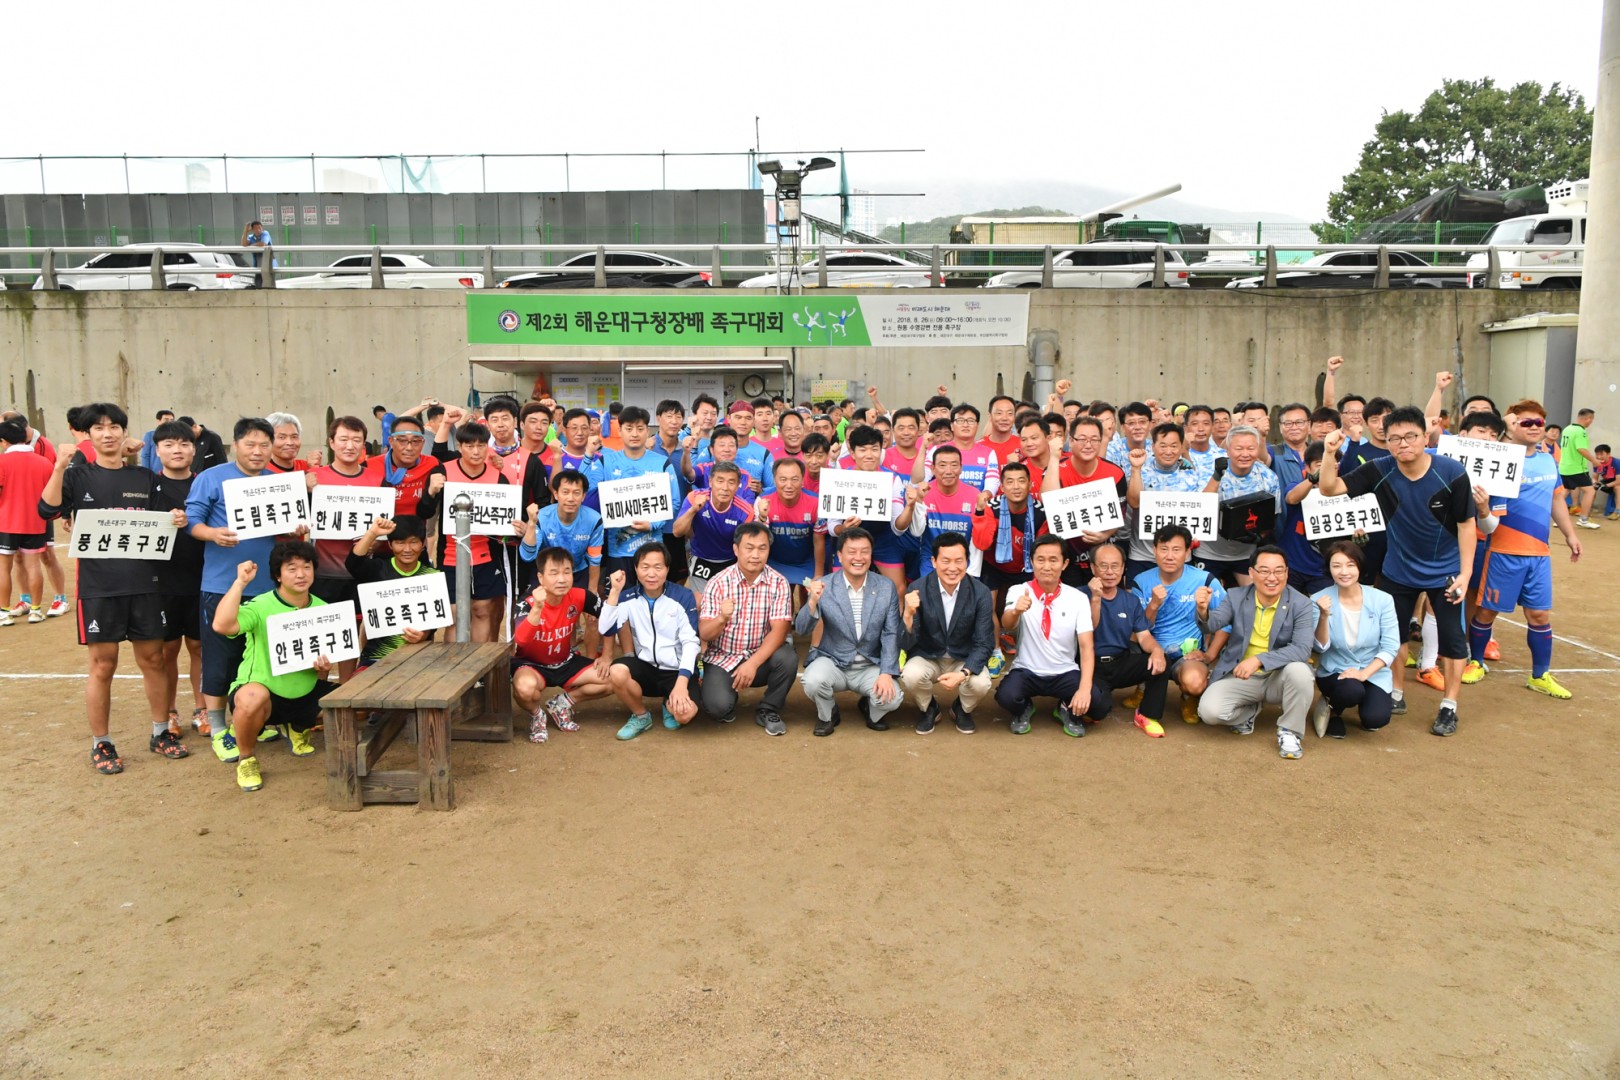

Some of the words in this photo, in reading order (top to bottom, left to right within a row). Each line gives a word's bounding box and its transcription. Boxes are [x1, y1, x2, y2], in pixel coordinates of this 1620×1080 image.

[525, 312, 568, 332] 제2회
[574, 311, 705, 334] 해운대구청장배
[710, 311, 784, 334] 족구대회
[1443, 452, 1517, 482] 지족구회
[243, 486, 267, 497] 해운대구
[269, 484, 292, 493] 족구협회
[327, 495, 356, 503] 부산광역시
[359, 496, 382, 504] 족구협회
[234, 499, 307, 530] 드림족구회
[605, 494, 669, 520] 재미사마족구회
[822, 494, 887, 516] 해마족구회
[97, 519, 127, 527] 해운대구
[941, 520, 968, 531] HORSE
[1053, 501, 1119, 533] 올킬족구회
[1309, 507, 1382, 534] 일공오족구회
[78, 533, 170, 553] 풍산족구회
[694, 564, 711, 579] 20
[376, 588, 402, 599] 해운대구
[404, 584, 429, 594] 족구협회
[282, 618, 314, 631] 부산광역시
[316, 613, 341, 625] 족구협회
[367, 598, 446, 629] 해운족구회
[533, 630, 553, 642] ALL
[275, 628, 354, 665] 안락족구회
[548, 642, 562, 656] 14
